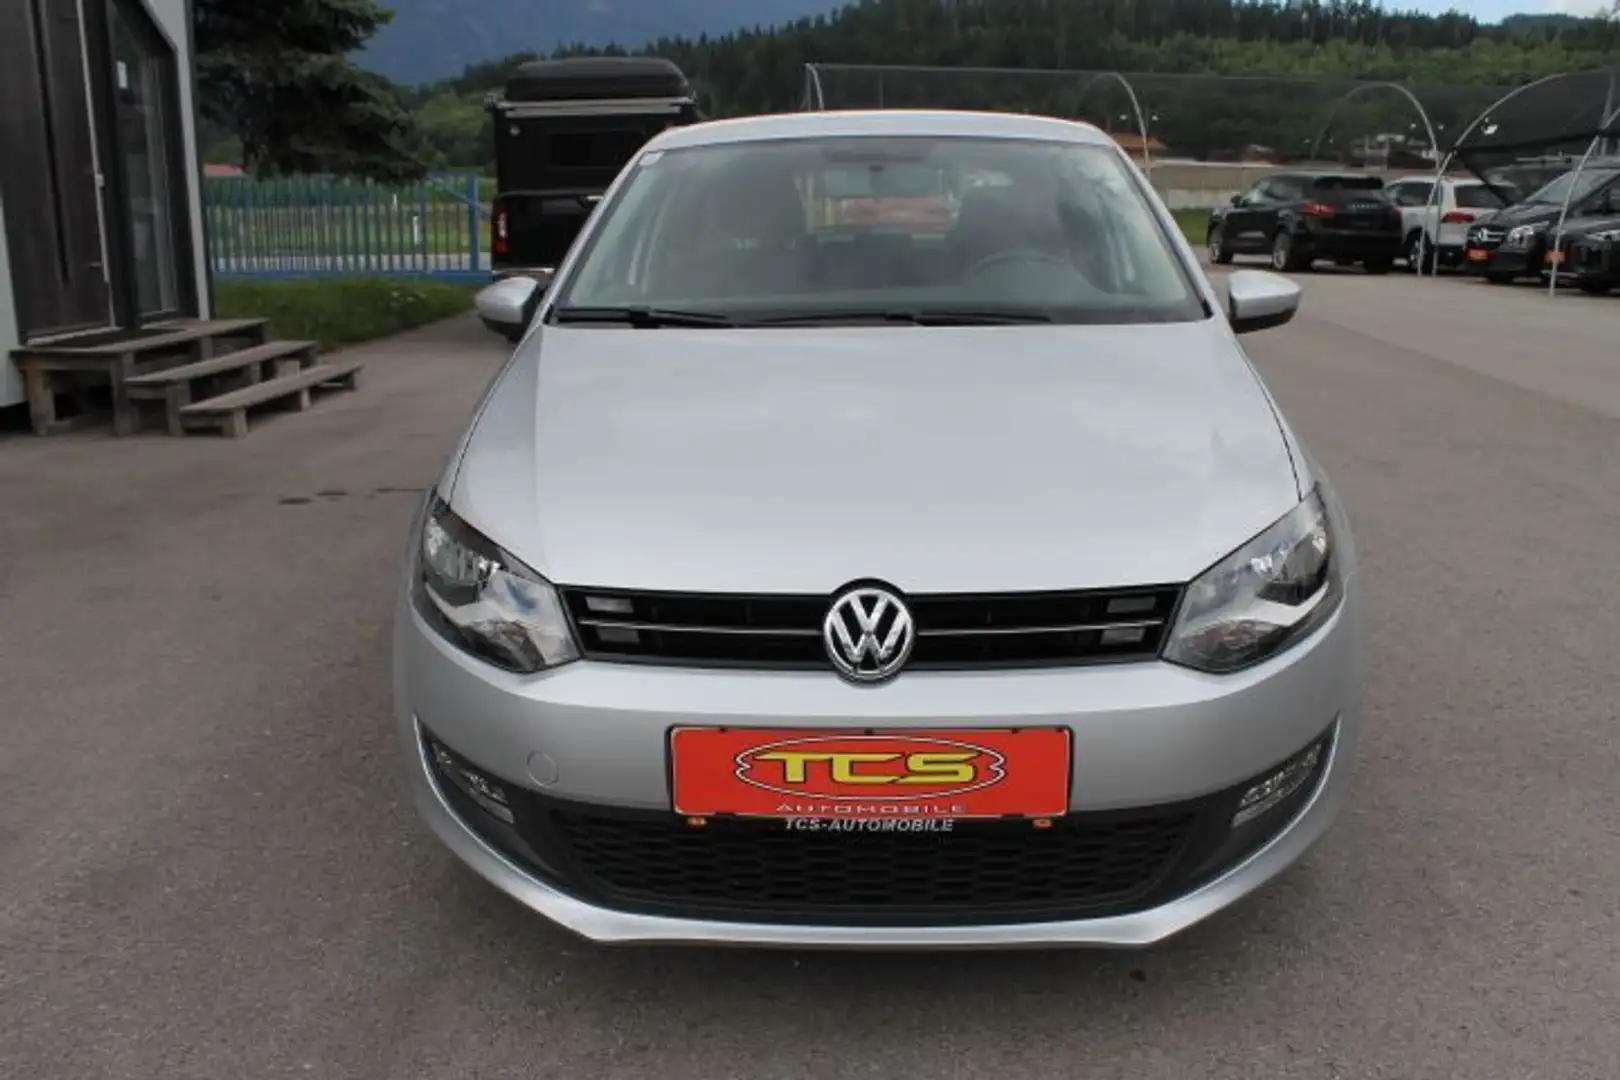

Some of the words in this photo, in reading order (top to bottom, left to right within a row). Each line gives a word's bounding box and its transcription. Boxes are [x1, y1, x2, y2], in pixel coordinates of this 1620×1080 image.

[826, 588, 913, 670] VW
[754, 751, 980, 784] TCS
[776, 803, 967, 814] AUTOMOBILE
[784, 818, 954, 833] TCS-AUTOMOBILE
